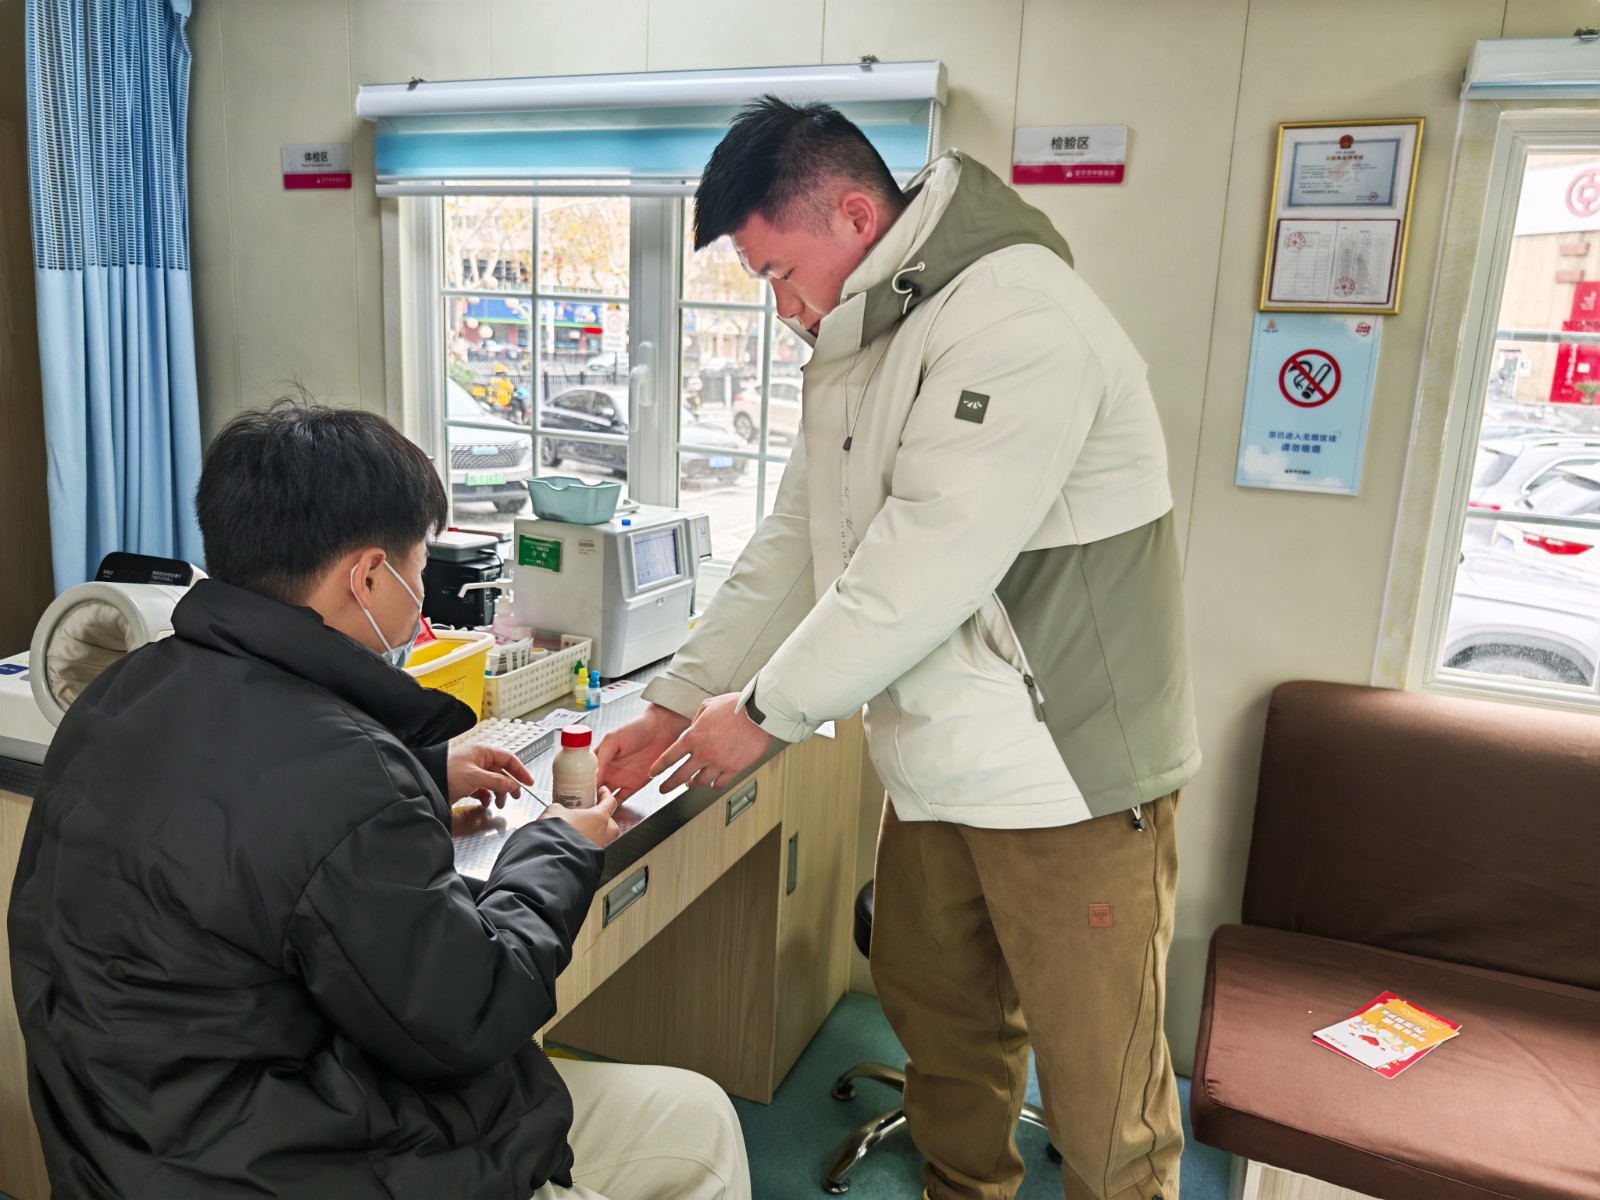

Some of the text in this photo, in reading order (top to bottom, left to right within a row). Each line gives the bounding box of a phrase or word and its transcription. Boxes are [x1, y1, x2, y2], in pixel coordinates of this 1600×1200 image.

[1051, 136, 1090, 150] 检验区
[304, 151, 329, 163] 体检区
[1268, 430, 1337, 443] 您已进入无烟区域
[1281, 443, 1322, 454] 请勿吸烟
